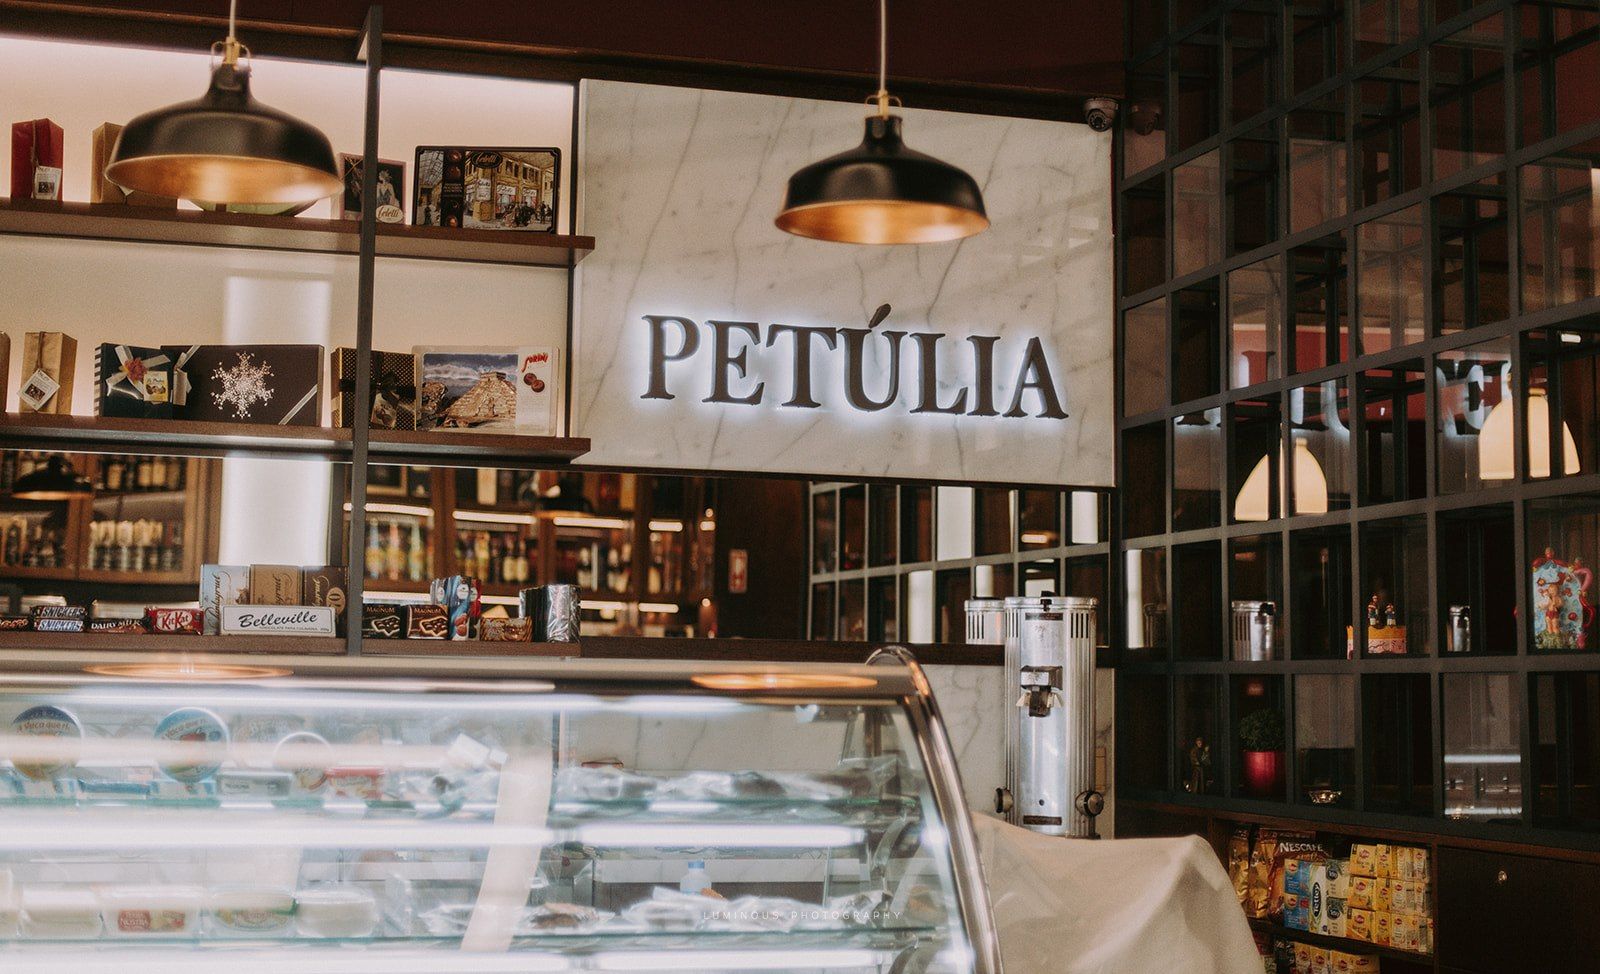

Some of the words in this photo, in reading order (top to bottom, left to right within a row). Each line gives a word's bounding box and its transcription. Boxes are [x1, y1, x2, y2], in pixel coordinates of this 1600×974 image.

[640, 303, 1070, 420] PETÚLIA
[42, 607, 84, 618] SNICKERS
[238, 611, 318, 628] Belleville
[40, 620, 83, 630] SNICKERS
